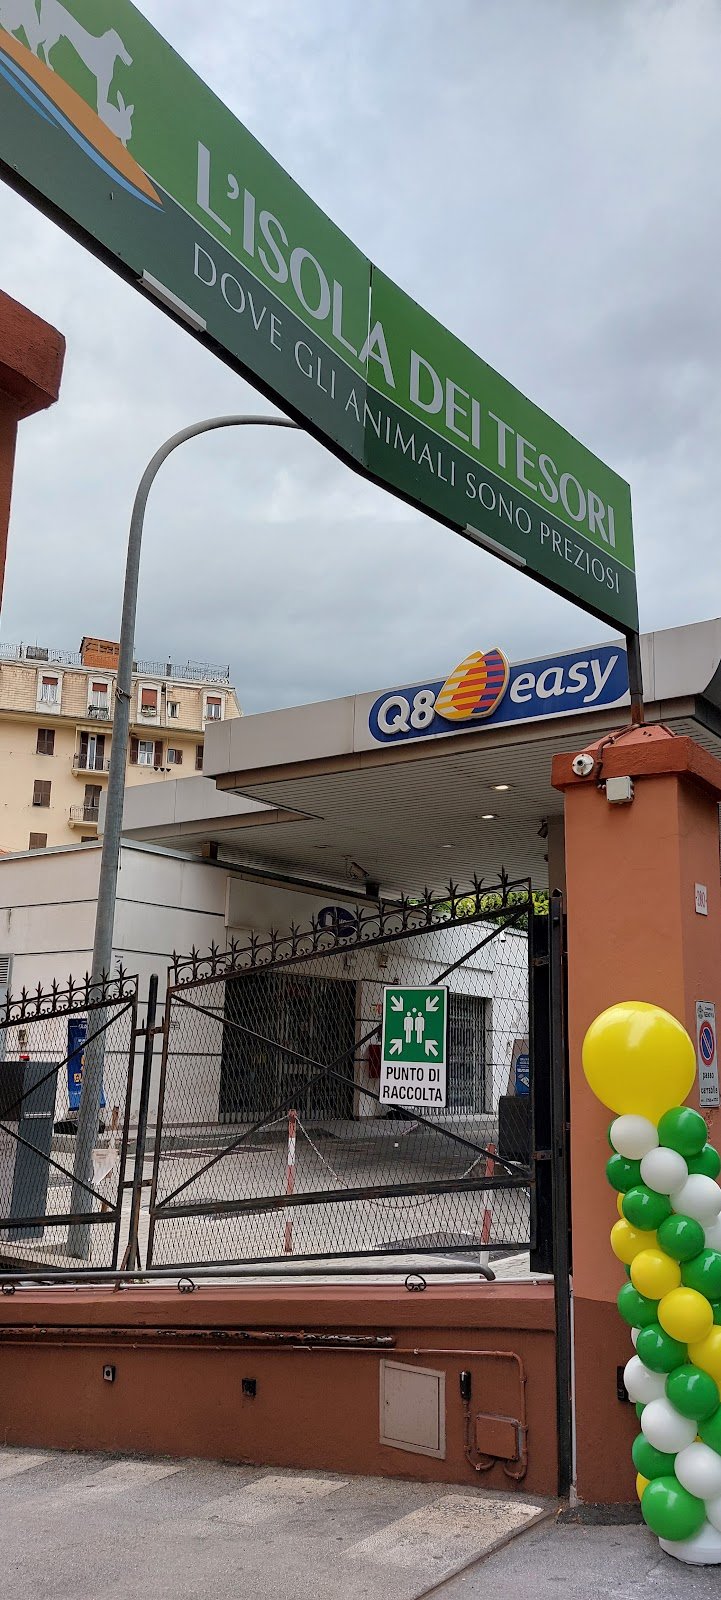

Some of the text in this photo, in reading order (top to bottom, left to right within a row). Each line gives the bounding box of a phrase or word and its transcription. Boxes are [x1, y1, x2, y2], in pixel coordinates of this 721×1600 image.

[197, 141, 616, 549] L'ISOLA DEI TESORI
[193, 242, 620, 594] DOVE GLI ANIMALI SONO PREZIOSI
[377, 655, 618, 735] Q8 easy
[382, 1085, 443, 1101] RACCOLTA
[386, 1066, 440, 1082] PUNTO DI
